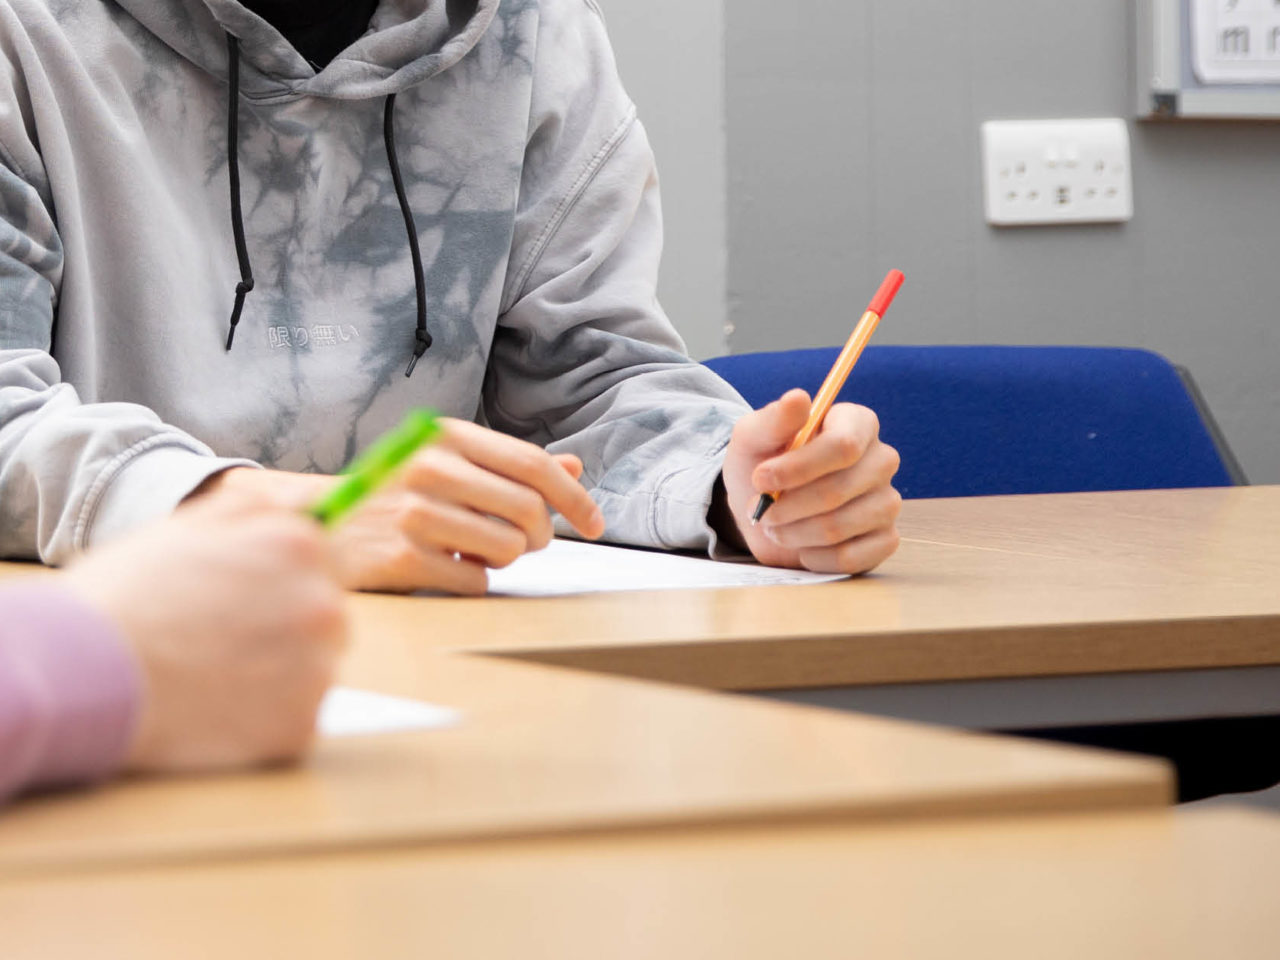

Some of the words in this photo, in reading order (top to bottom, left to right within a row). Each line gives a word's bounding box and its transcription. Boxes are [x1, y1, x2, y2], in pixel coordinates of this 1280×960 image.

[1222, 26, 1250, 53] m
[268, 325, 359, 347] 限り無い
